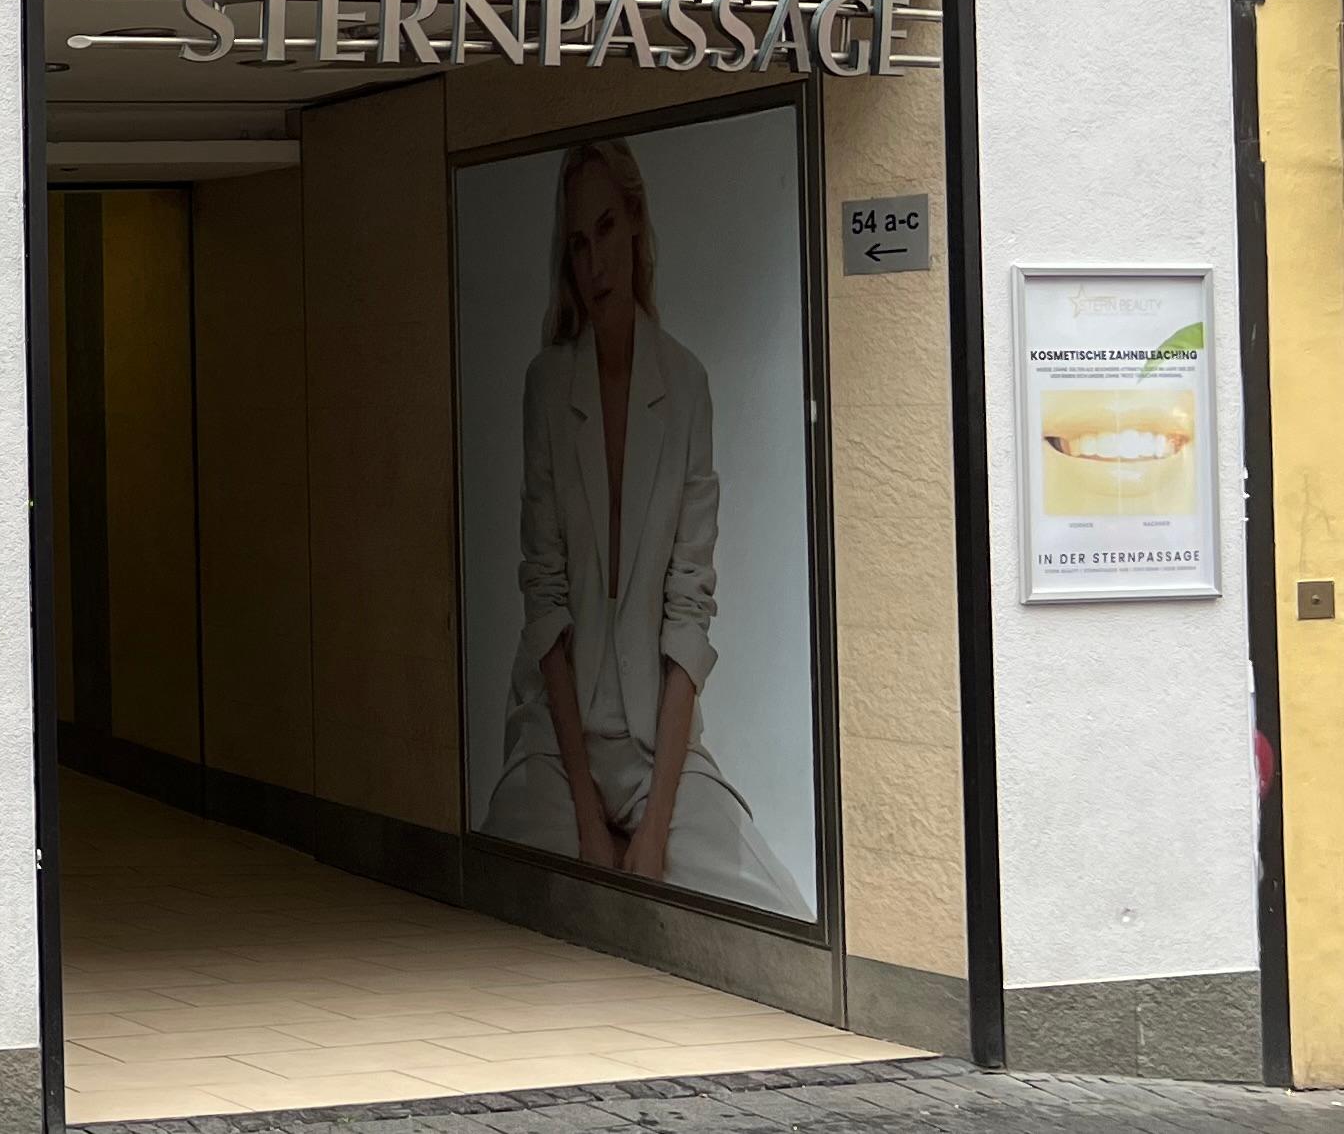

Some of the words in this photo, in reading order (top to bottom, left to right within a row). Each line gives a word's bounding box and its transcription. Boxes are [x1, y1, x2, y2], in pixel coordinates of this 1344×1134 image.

[851, 210, 878, 235] 54
[885, 210, 920, 233] a-c
[1029, 350, 1108, 362] KOSMETISCHE
[1109, 349, 1198, 362] ZAHNBLEACHING
[1038, 553, 1053, 565] IN
[1059, 553, 1086, 565] DER
[1092, 550, 1201, 565] STERNPASSAGE
